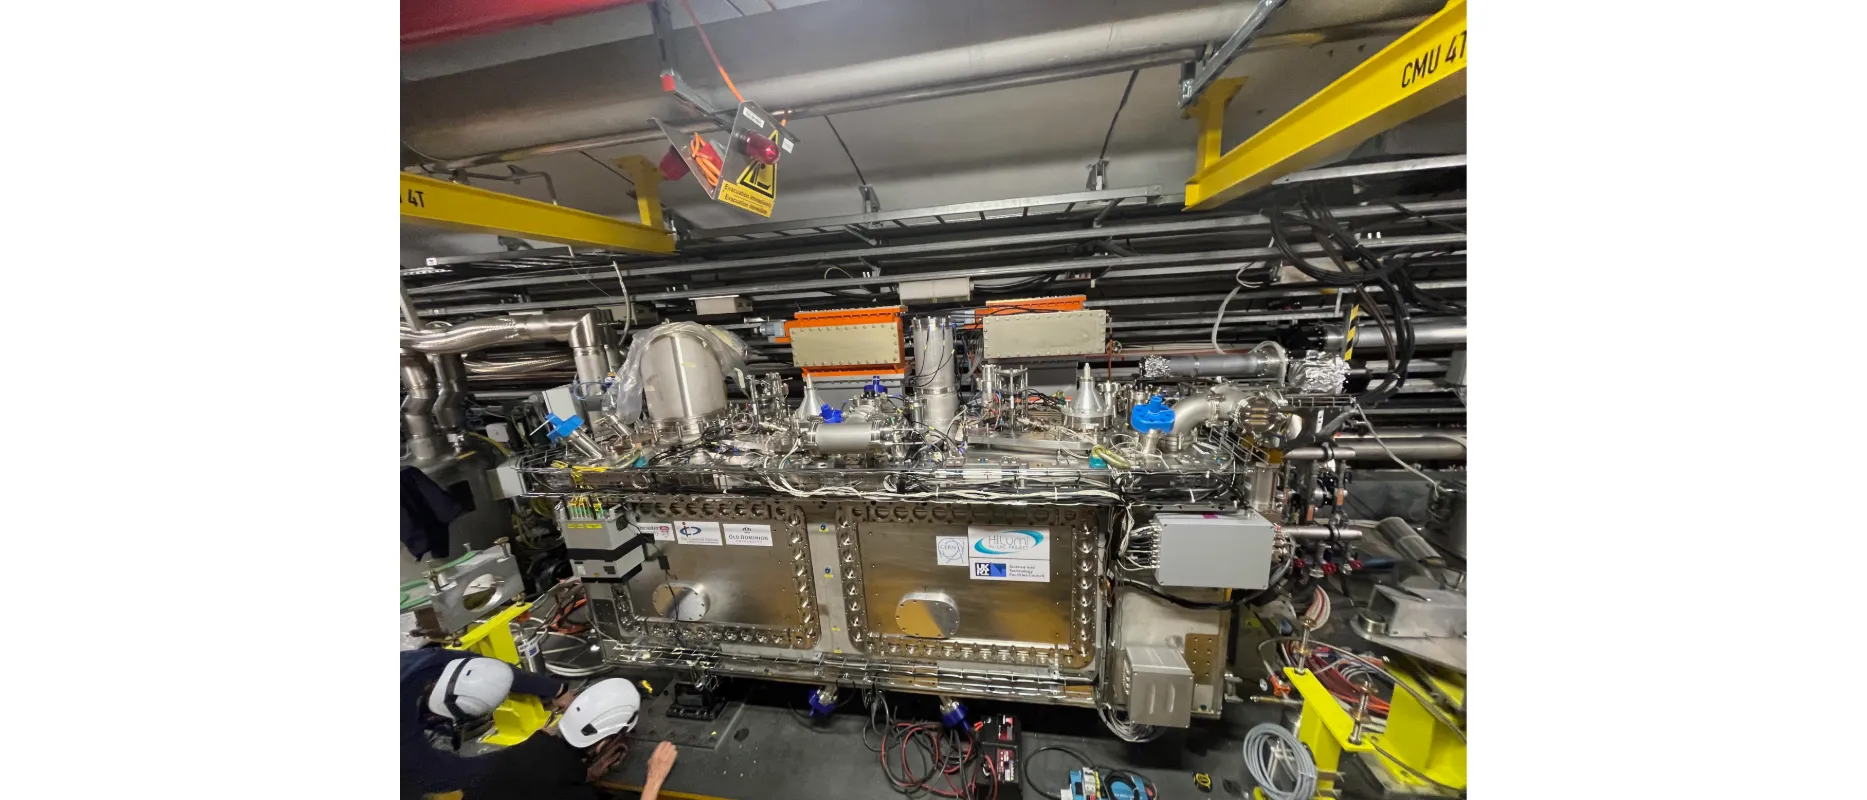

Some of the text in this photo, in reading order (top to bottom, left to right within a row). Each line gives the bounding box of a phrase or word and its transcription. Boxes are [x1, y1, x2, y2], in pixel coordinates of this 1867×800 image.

[1401, 44, 1441, 88] CMU
[408, 189, 424, 208] 4T
[724, 183, 750, 198] Evacuation
[724, 194, 749, 207] Evacuation
